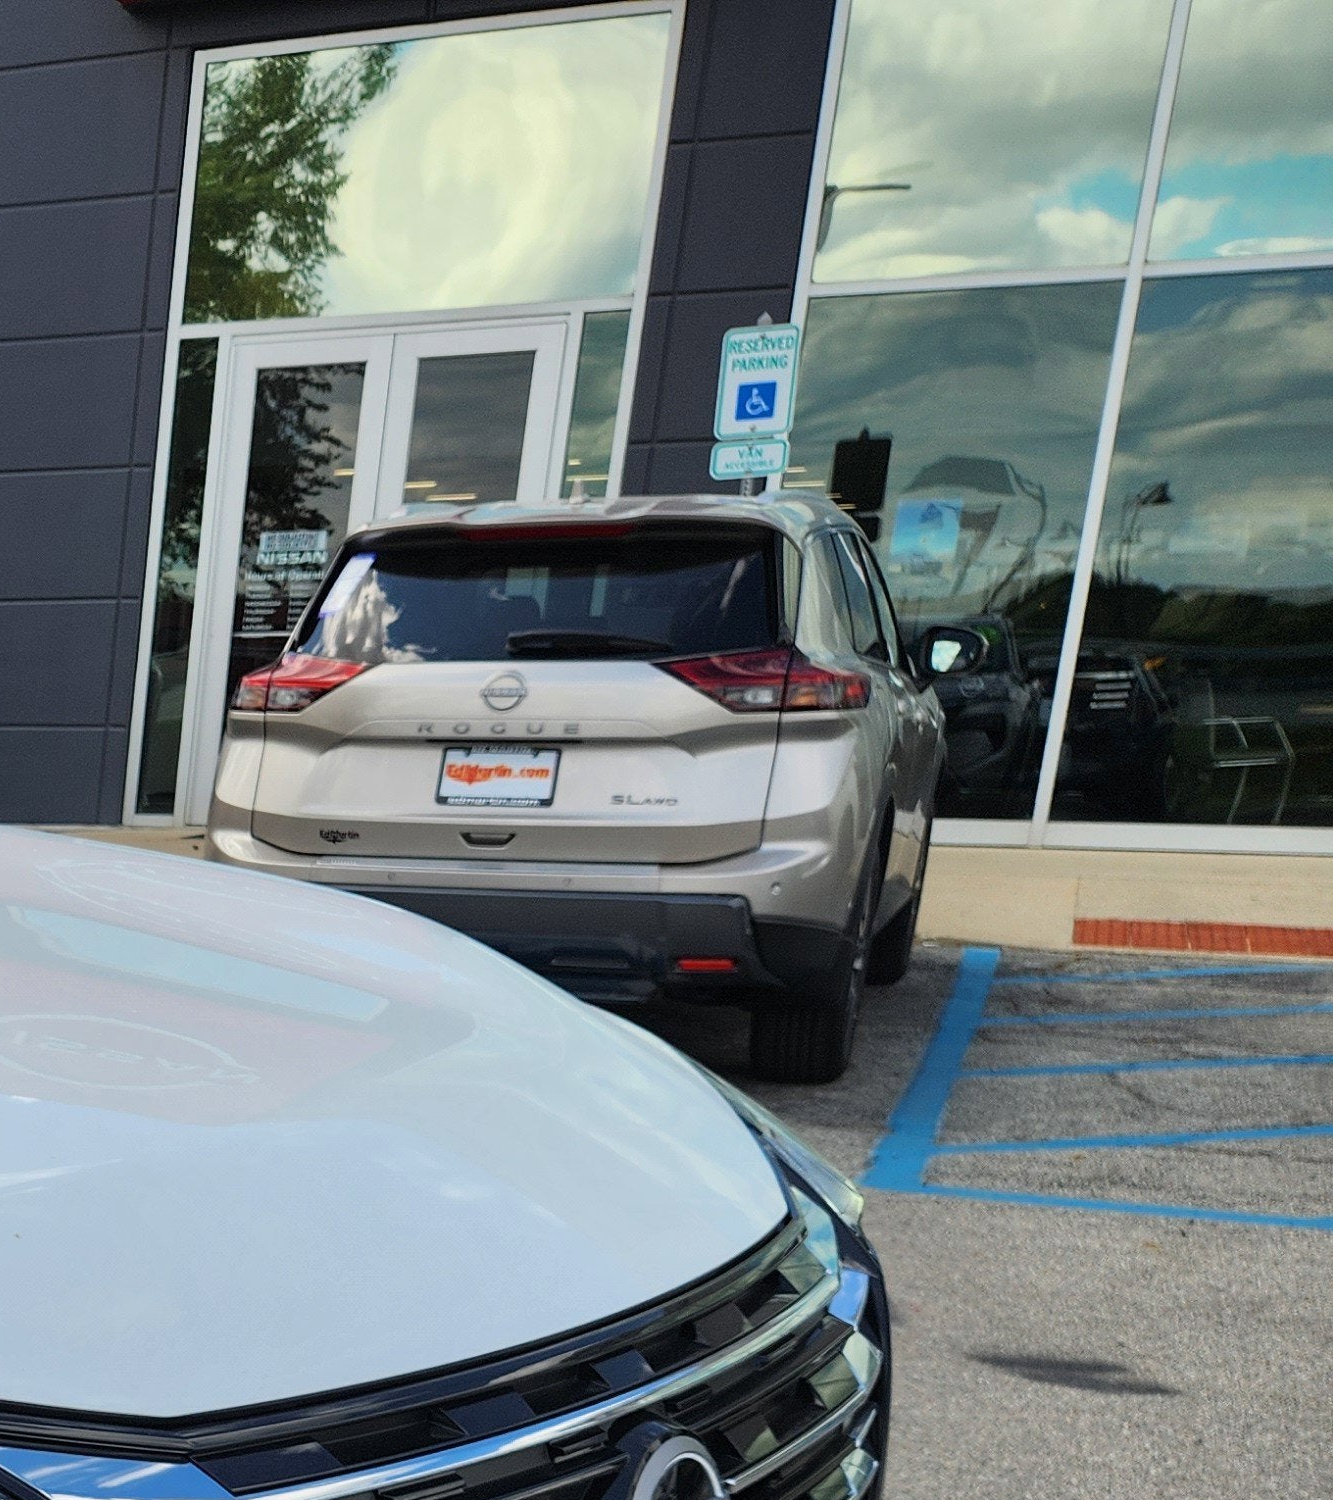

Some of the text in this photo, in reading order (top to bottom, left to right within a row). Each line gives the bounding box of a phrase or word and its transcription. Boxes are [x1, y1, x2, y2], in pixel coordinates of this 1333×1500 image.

[728, 337, 794, 353] RESERVED
[732, 355, 788, 372] PARKING
[737, 448, 764, 459] VAN
[256, 551, 328, 566] NISSAN
[417, 722, 580, 735] ROGUE
